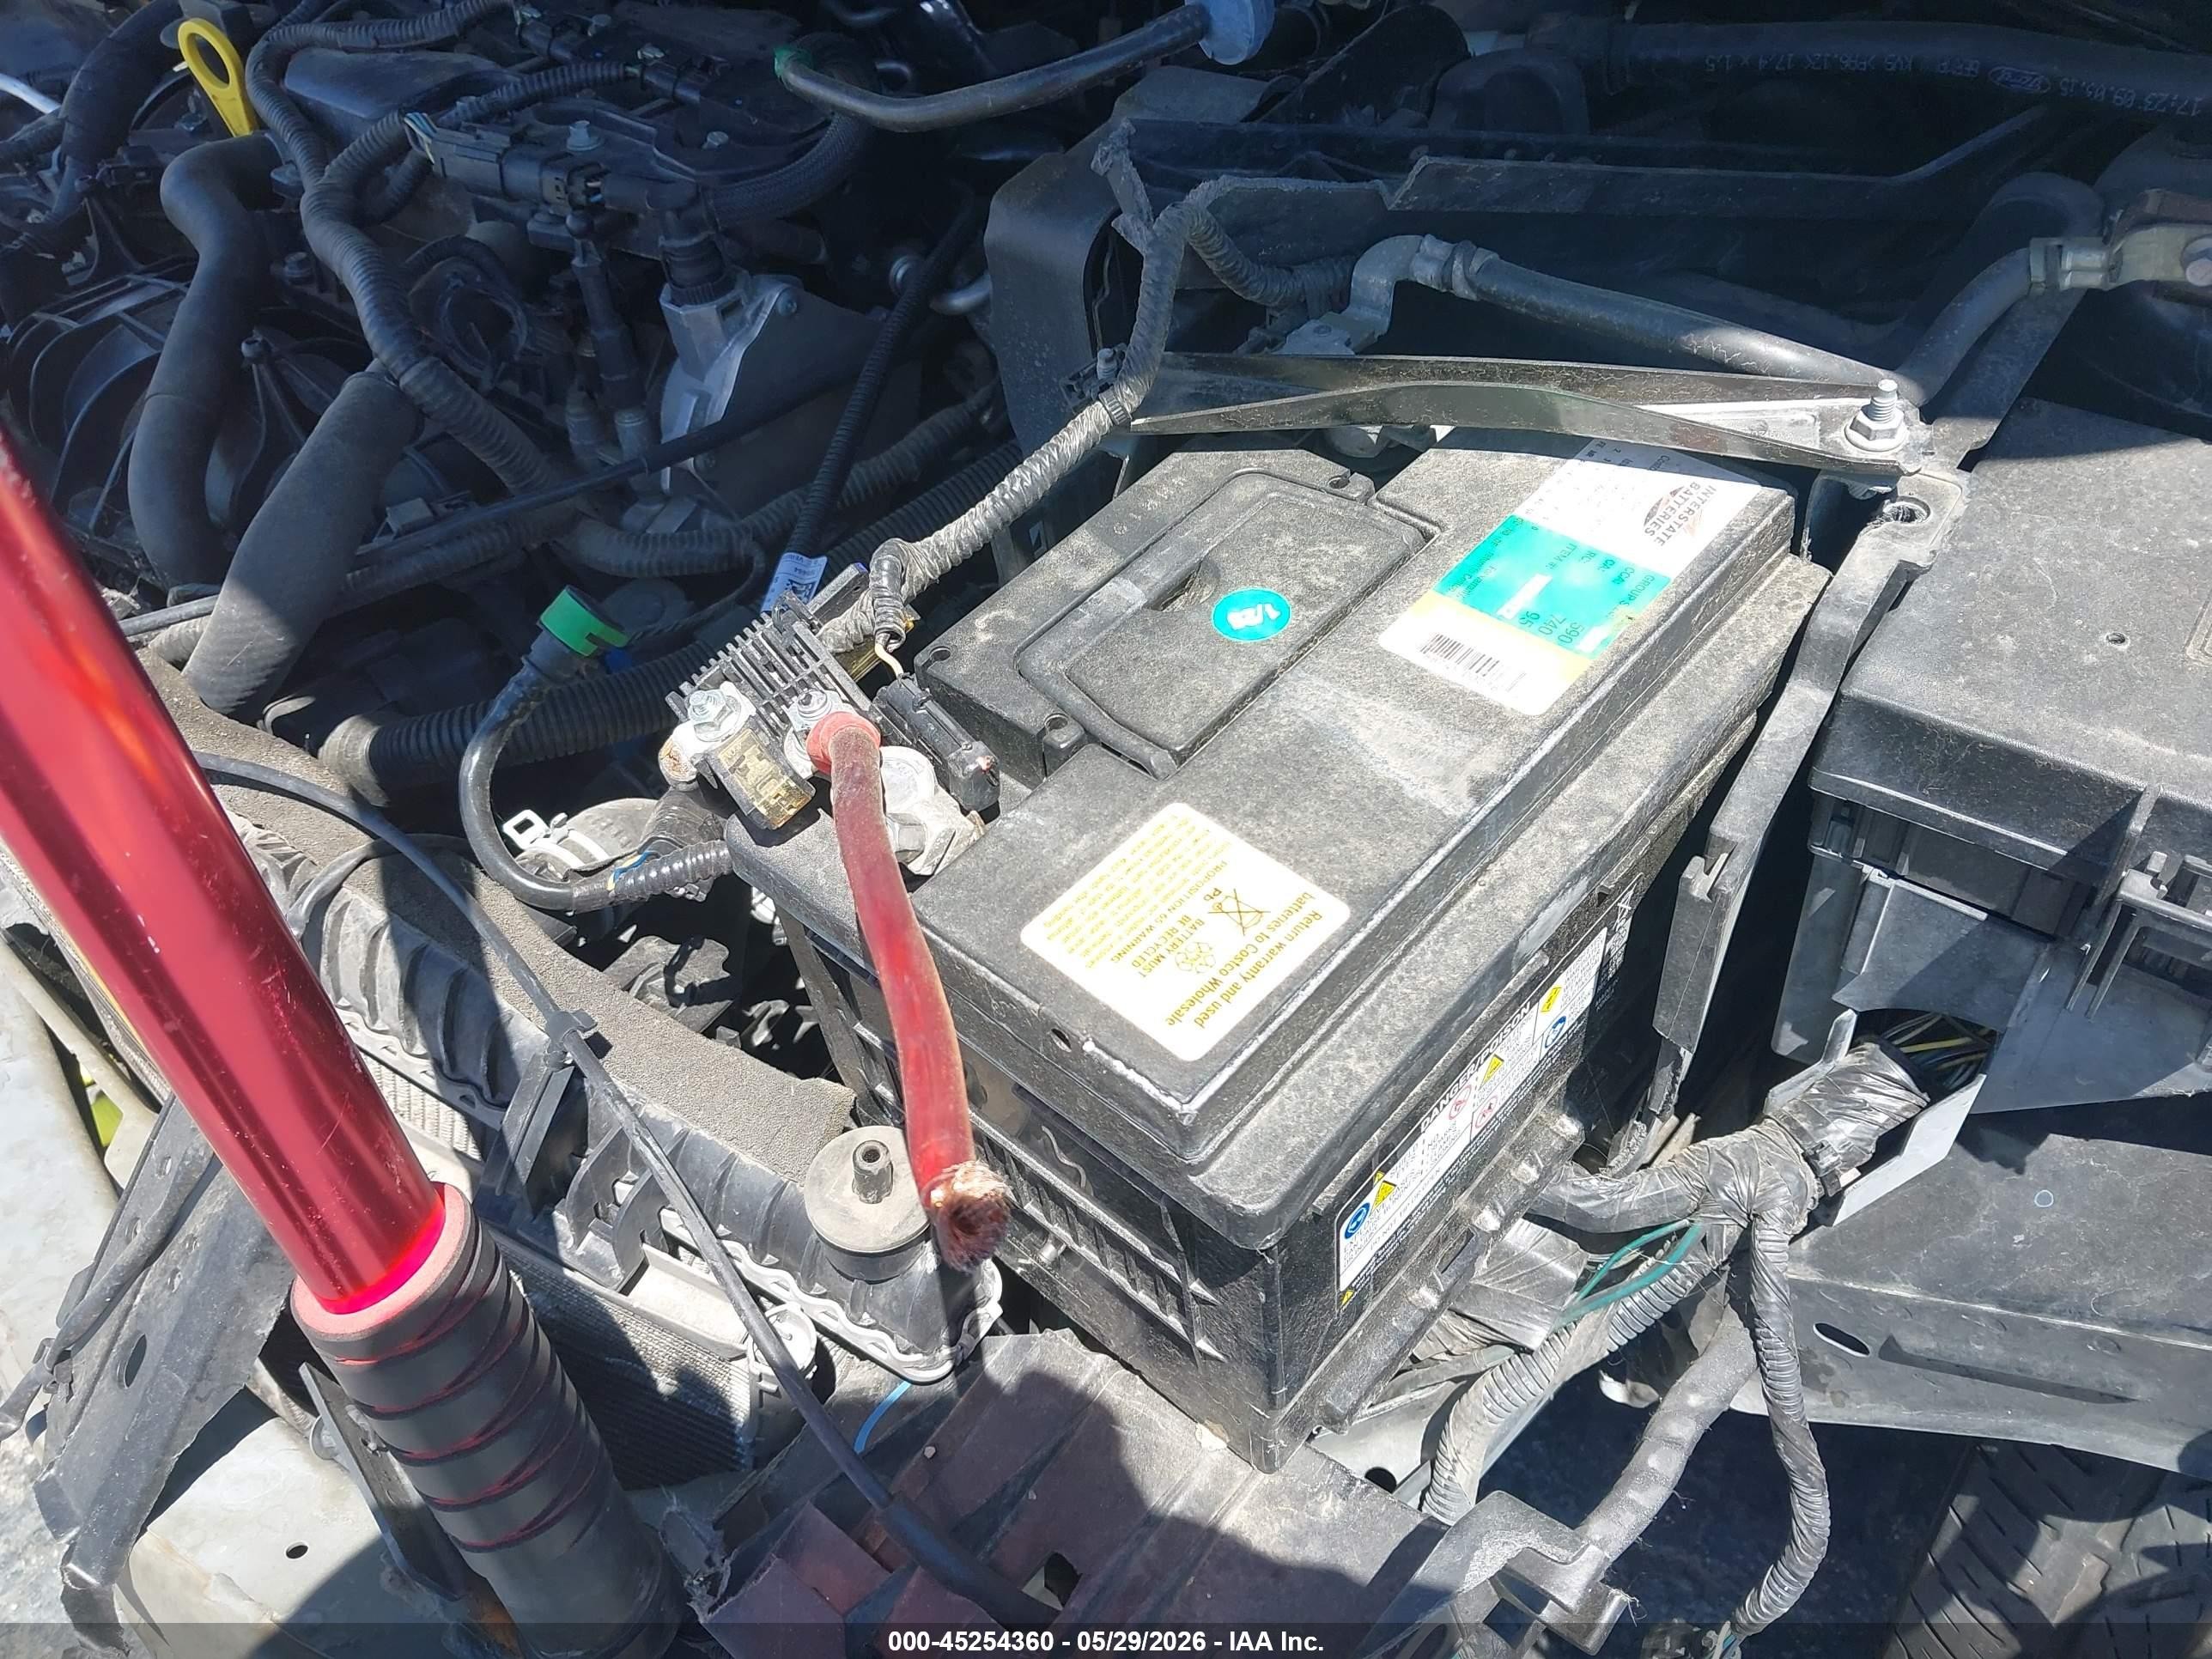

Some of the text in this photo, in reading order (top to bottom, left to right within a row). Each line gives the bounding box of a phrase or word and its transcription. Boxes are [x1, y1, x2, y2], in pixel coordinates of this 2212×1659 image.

[1644, 482, 1701, 535] BATTERIES
[1654, 485, 1717, 545] INTERSTATE
[1553, 543, 1577, 562] ITEM
[1517, 550, 1596, 627] RC: 95
[1536, 558, 1615, 635] CA: 740
[1556, 567, 1635, 644] CCA: 590
[1626, 574, 1655, 600] GROUP
[1110, 860, 1226, 962] PROPOSITION 65 WARNING
[1203, 887, 1222, 902] Pb
[1131, 915, 1191, 968] BE RECYCLED
[1140, 918, 1204, 977] BATTERY MUST
[1166, 891, 1313, 1026] batteries to Costco Wholesale
[1193, 910, 1322, 1028] Return warranty and used
[1420, 1001, 1530, 1133] DANGER/POISON
[1343, 1202, 1384, 1253] EXPLOSIVE
